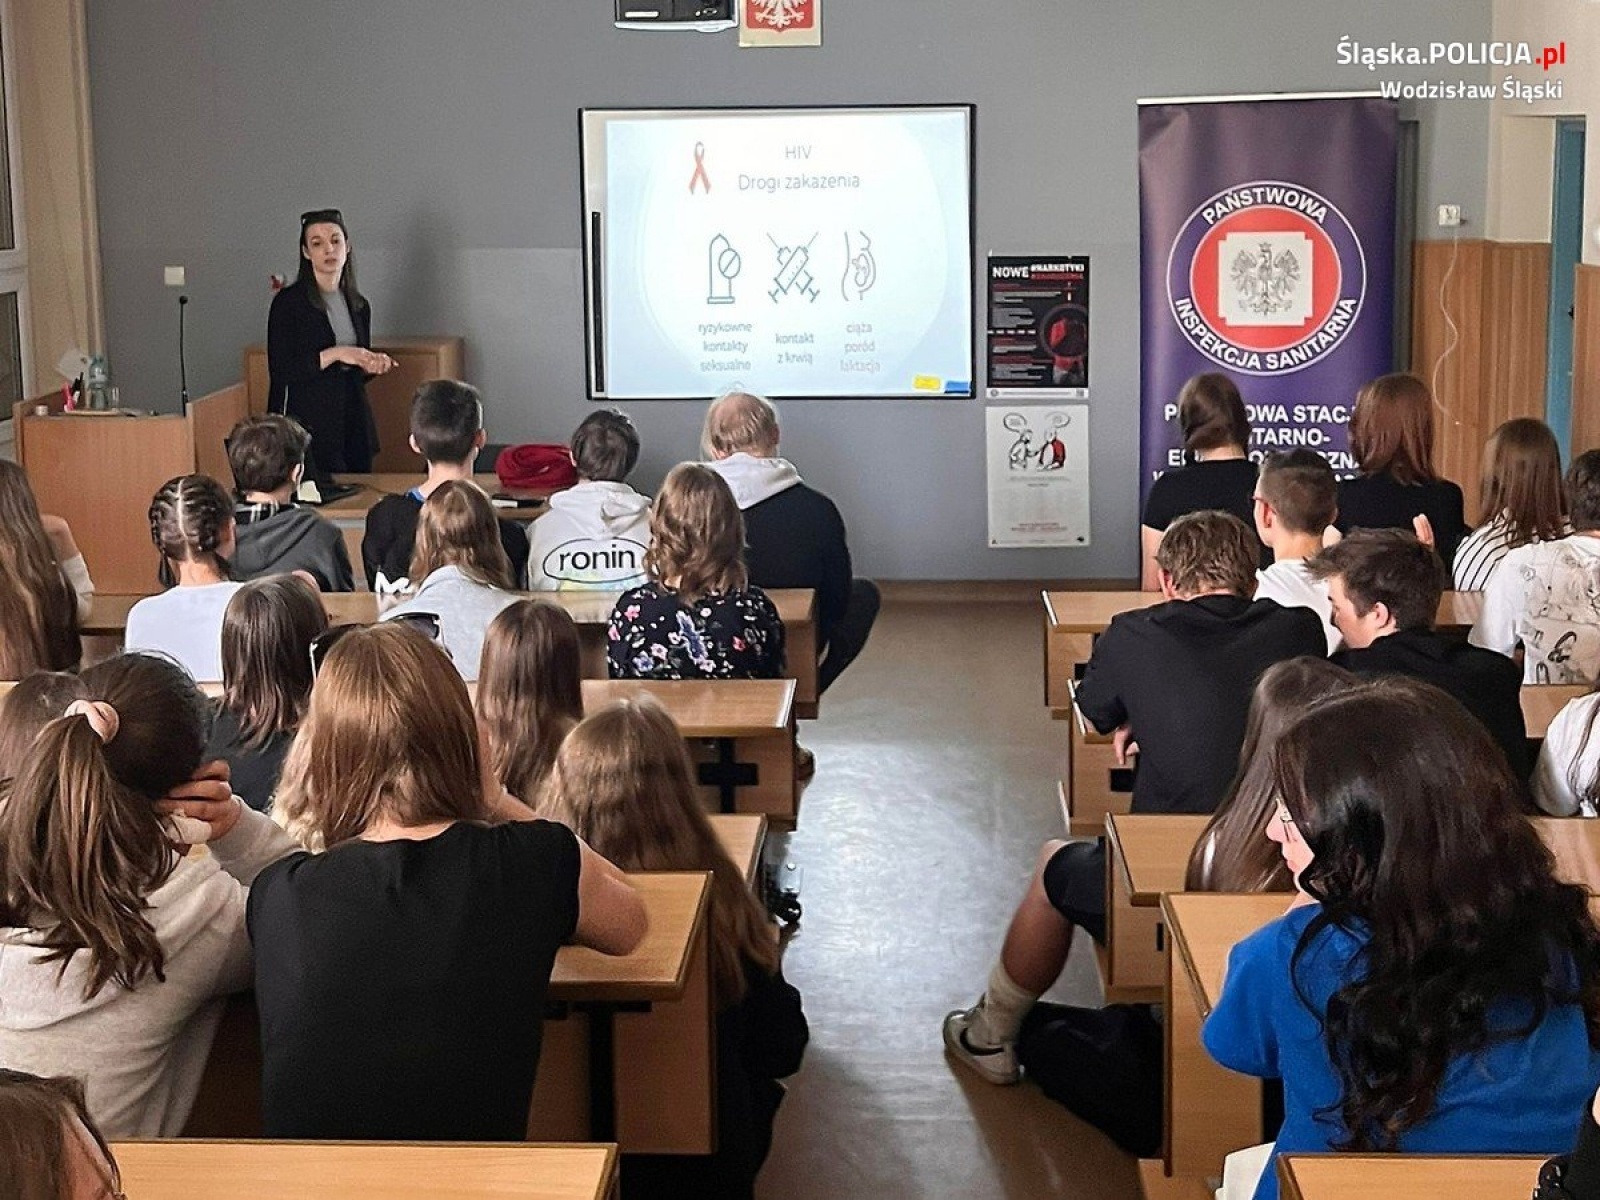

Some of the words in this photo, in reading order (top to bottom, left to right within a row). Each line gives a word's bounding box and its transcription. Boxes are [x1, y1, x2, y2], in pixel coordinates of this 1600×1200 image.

[785, 145, 812, 159] HIV
[738, 174, 780, 194] Drogi
[1202, 186, 1328, 225] PAŃSTWOWA
[992, 266, 1030, 279] NOWE
[775, 332, 815, 345] kontakt
[1175, 298, 1261, 370] INSPEKCJA
[1266, 298, 1357, 370] SANITARNA
[703, 340, 749, 354] kontakty
[1293, 404, 1355, 424] STAC
[559, 543, 636, 572] ronin
